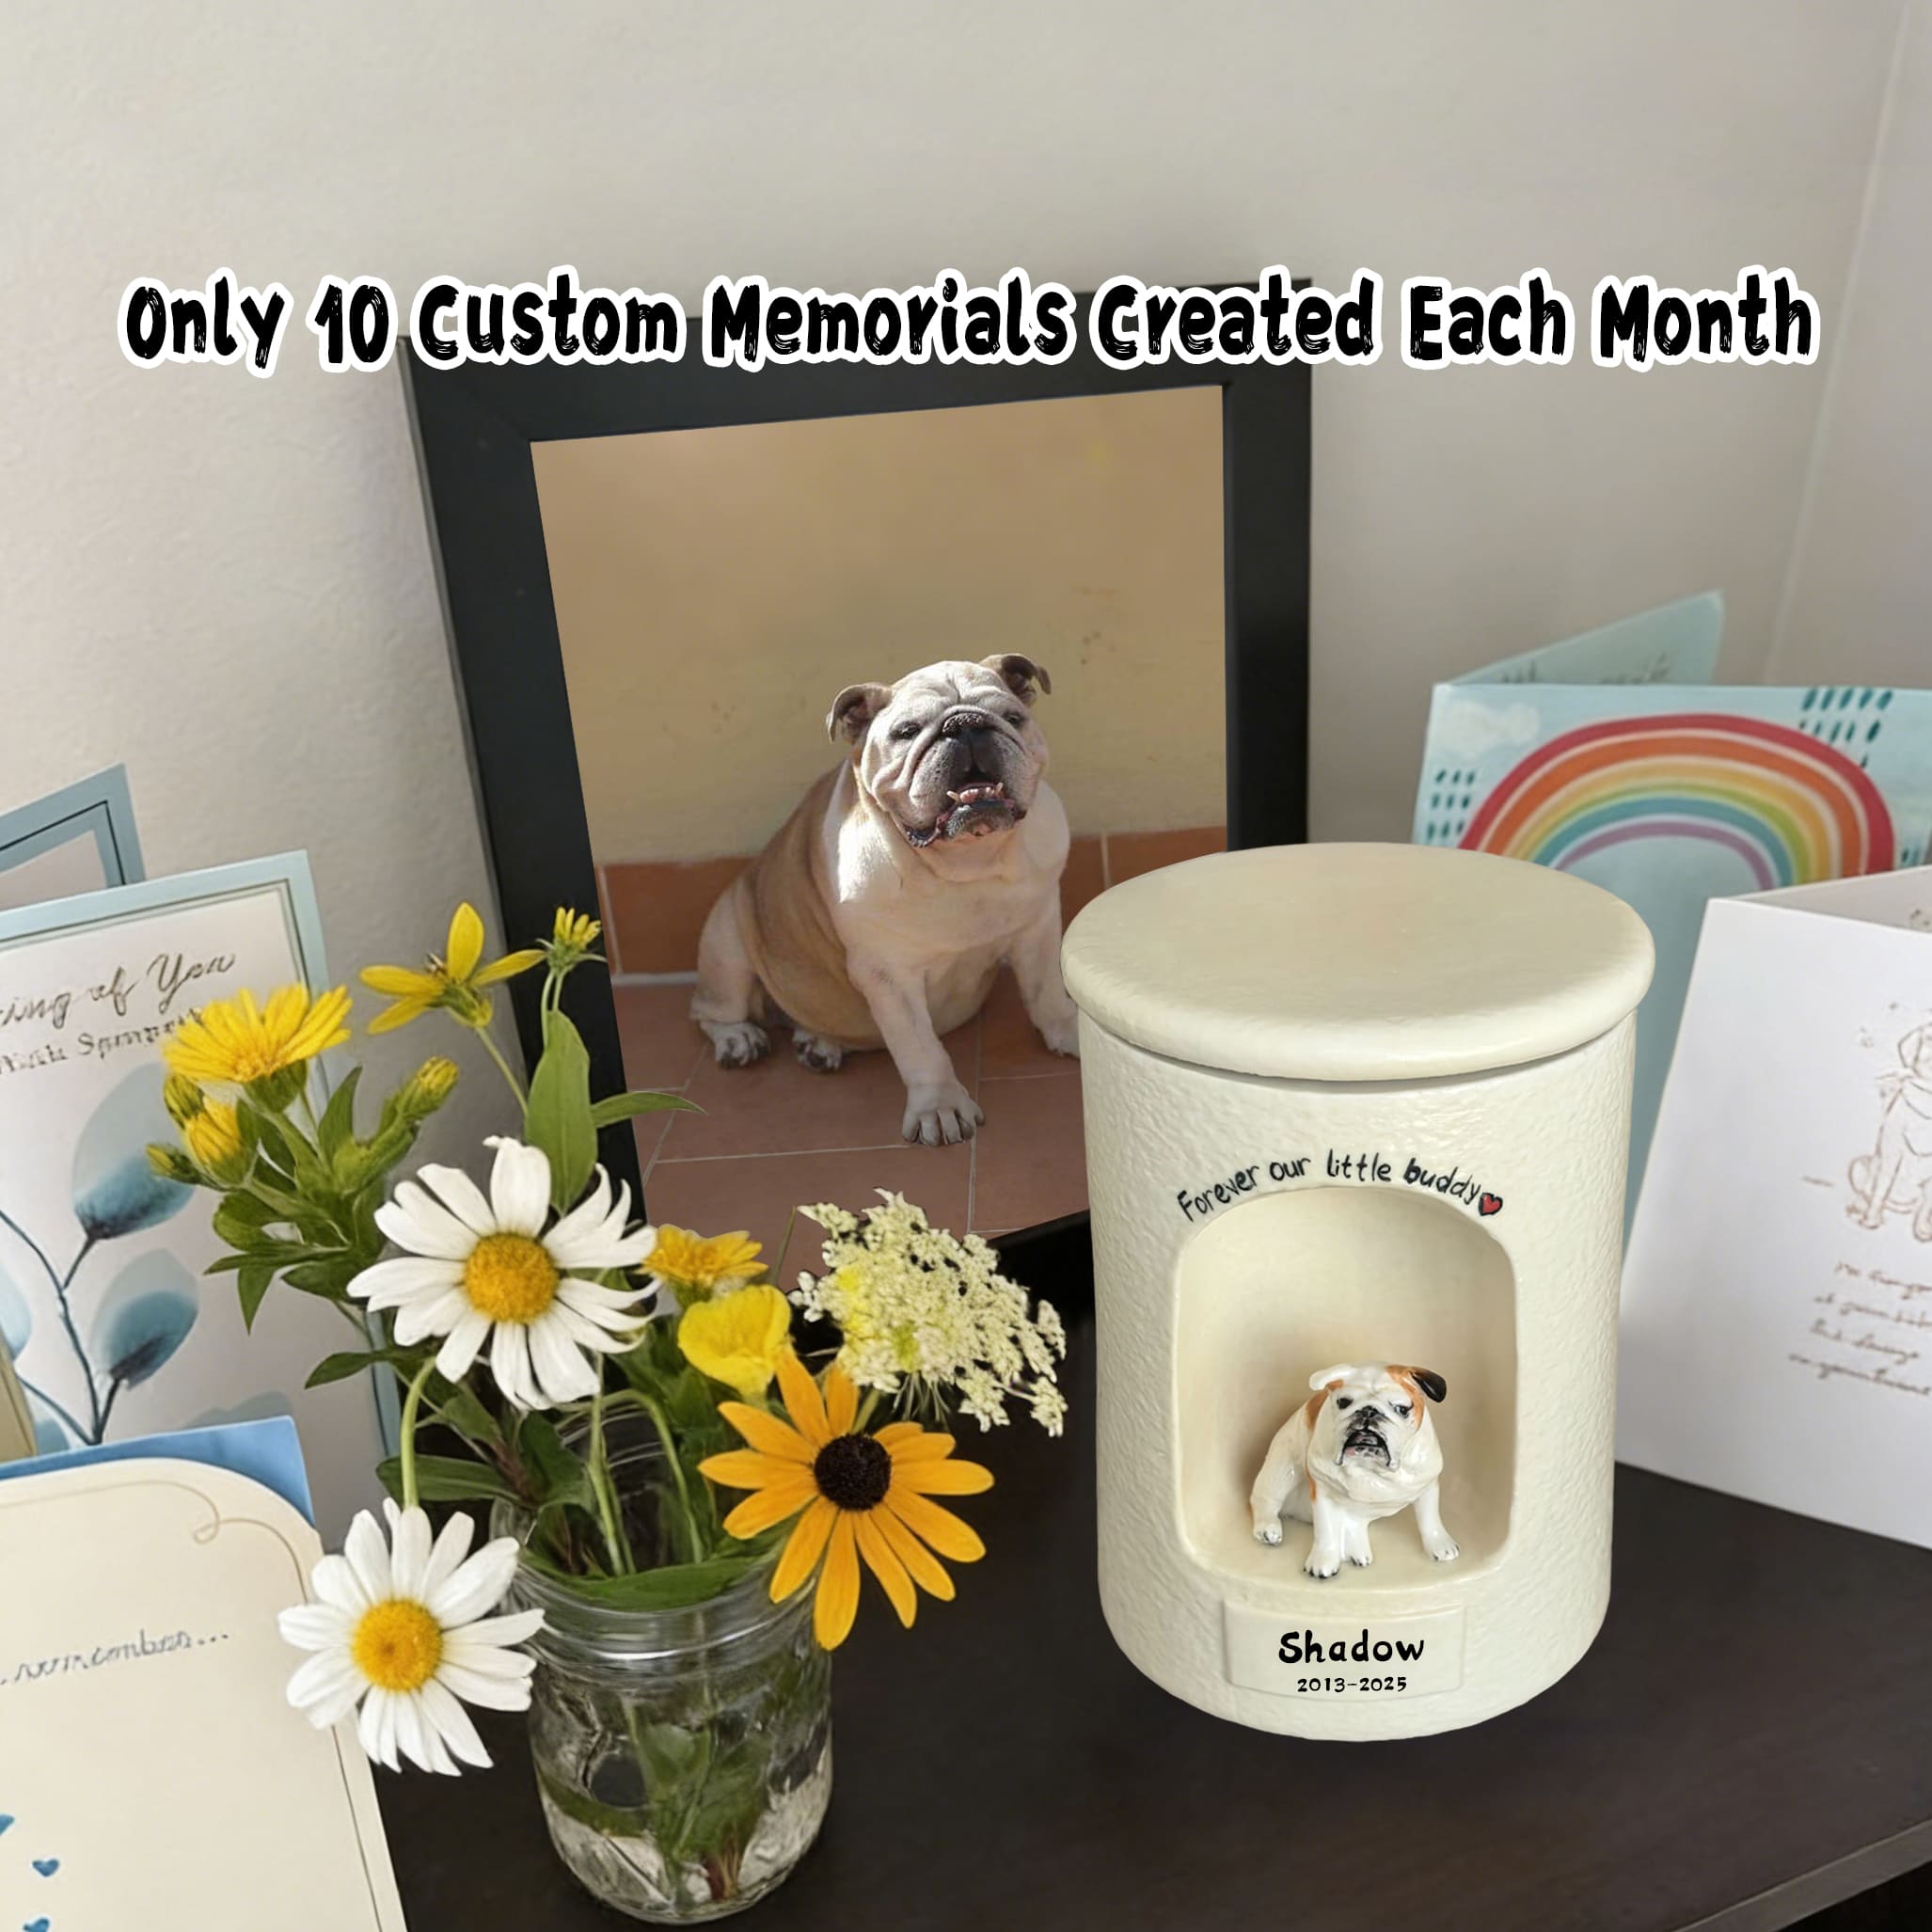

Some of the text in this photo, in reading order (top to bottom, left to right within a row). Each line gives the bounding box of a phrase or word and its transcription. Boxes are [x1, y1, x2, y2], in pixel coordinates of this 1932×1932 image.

[1176, 1148, 1481, 1223] Forever our little buddy
[1278, 1628, 1425, 1664] Shadow
[1297, 1676, 1407, 1693] 2013-2025
